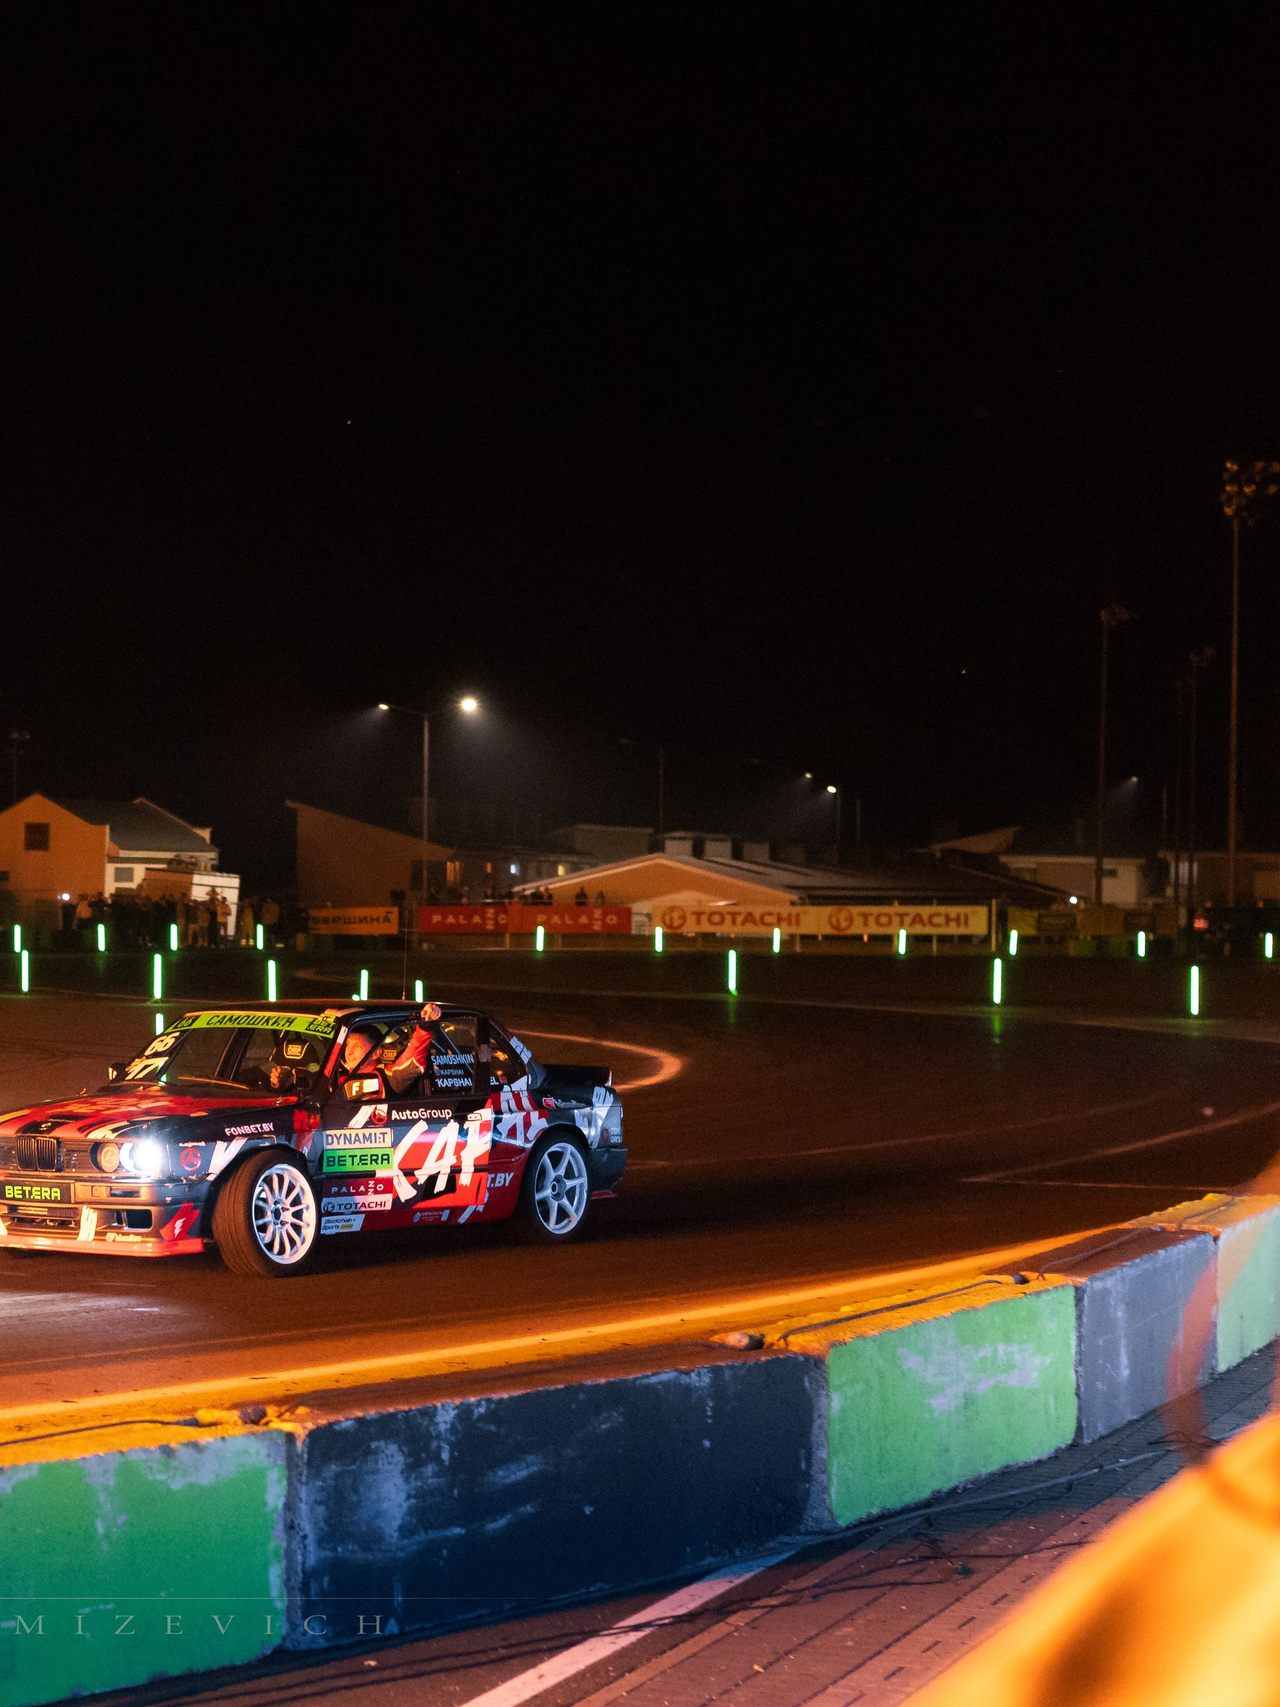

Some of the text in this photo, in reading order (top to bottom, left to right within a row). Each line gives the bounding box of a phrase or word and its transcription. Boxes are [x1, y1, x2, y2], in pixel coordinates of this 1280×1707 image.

[692, 911, 801, 927] TOTACHI
[859, 911, 969, 928] TOTACHI
[206, 1015, 296, 1028] САМОШКИН
[144, 1032, 180, 1056] 66
[431, 1054, 474, 1066] SAMOSHKIN
[436, 1077, 472, 1087] KAPSHAI
[391, 1108, 452, 1121] AutoGroup
[224, 1122, 274, 1137] FONBET.BY
[337, 1201, 386, 1211] TOTACHI
